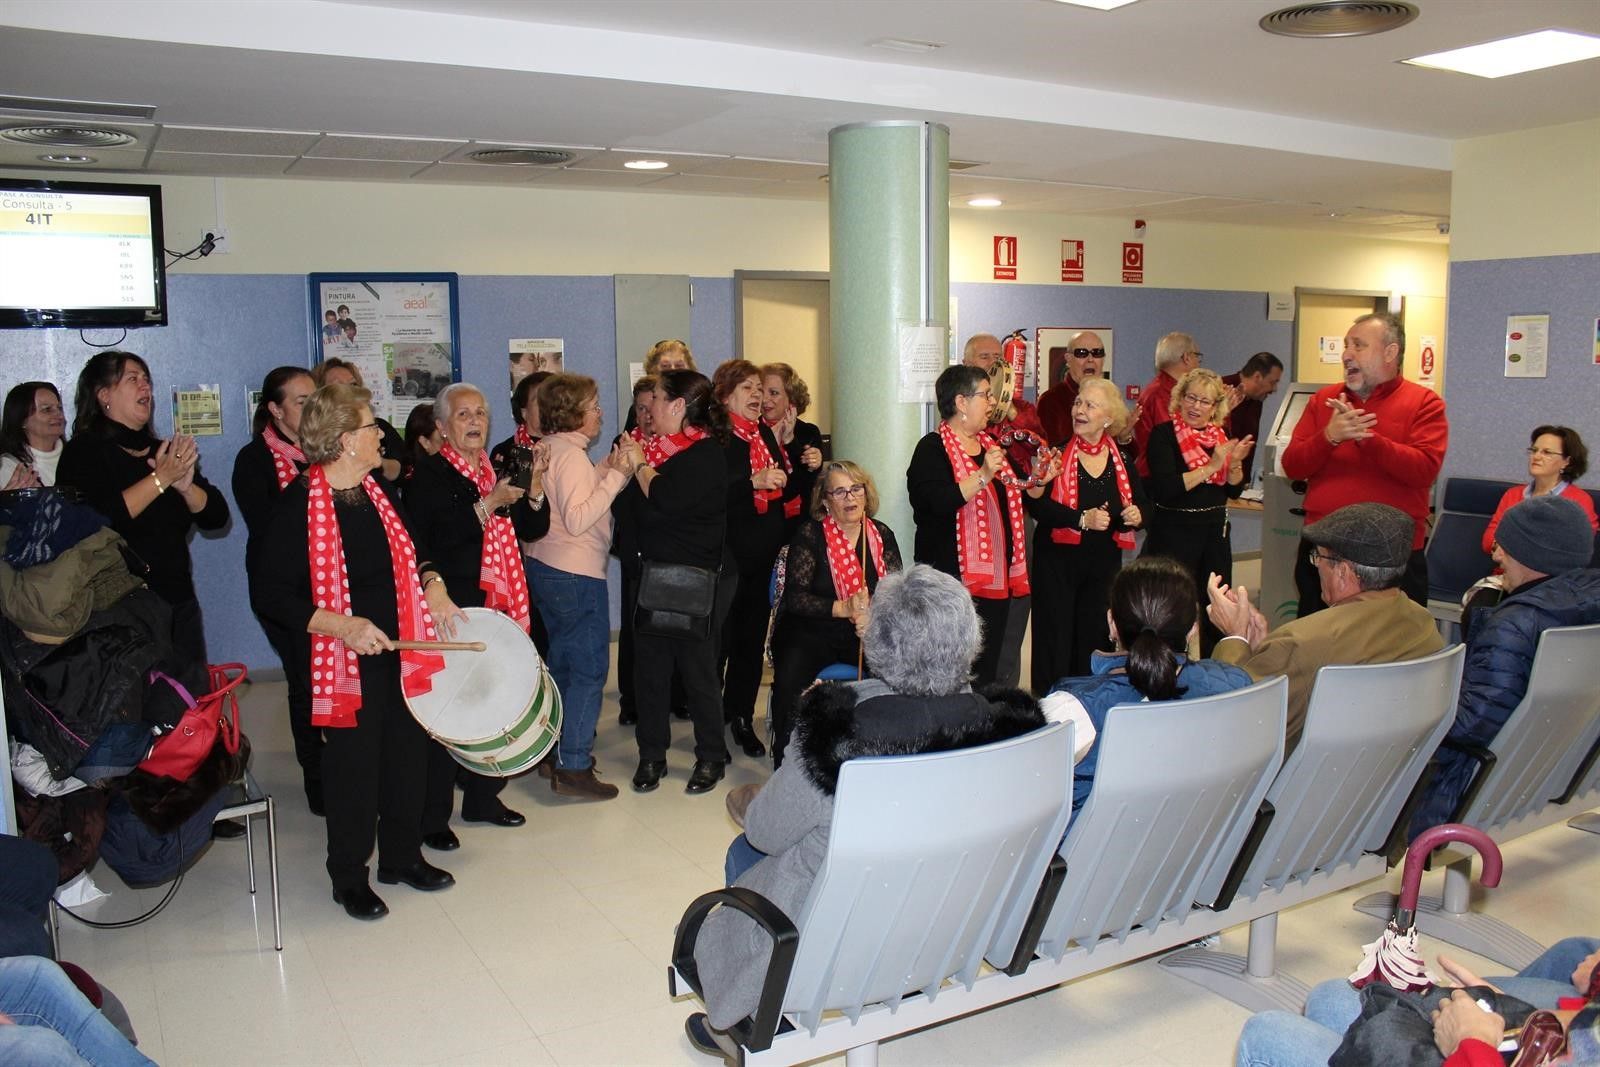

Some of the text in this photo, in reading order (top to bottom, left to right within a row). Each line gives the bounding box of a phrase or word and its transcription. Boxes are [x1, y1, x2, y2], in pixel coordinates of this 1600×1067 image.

[2, 199, 54, 210] Consulta
[65, 201, 73, 211] 5
[25, 212, 53, 225] 4IT
[404, 296, 427, 310] aeal
